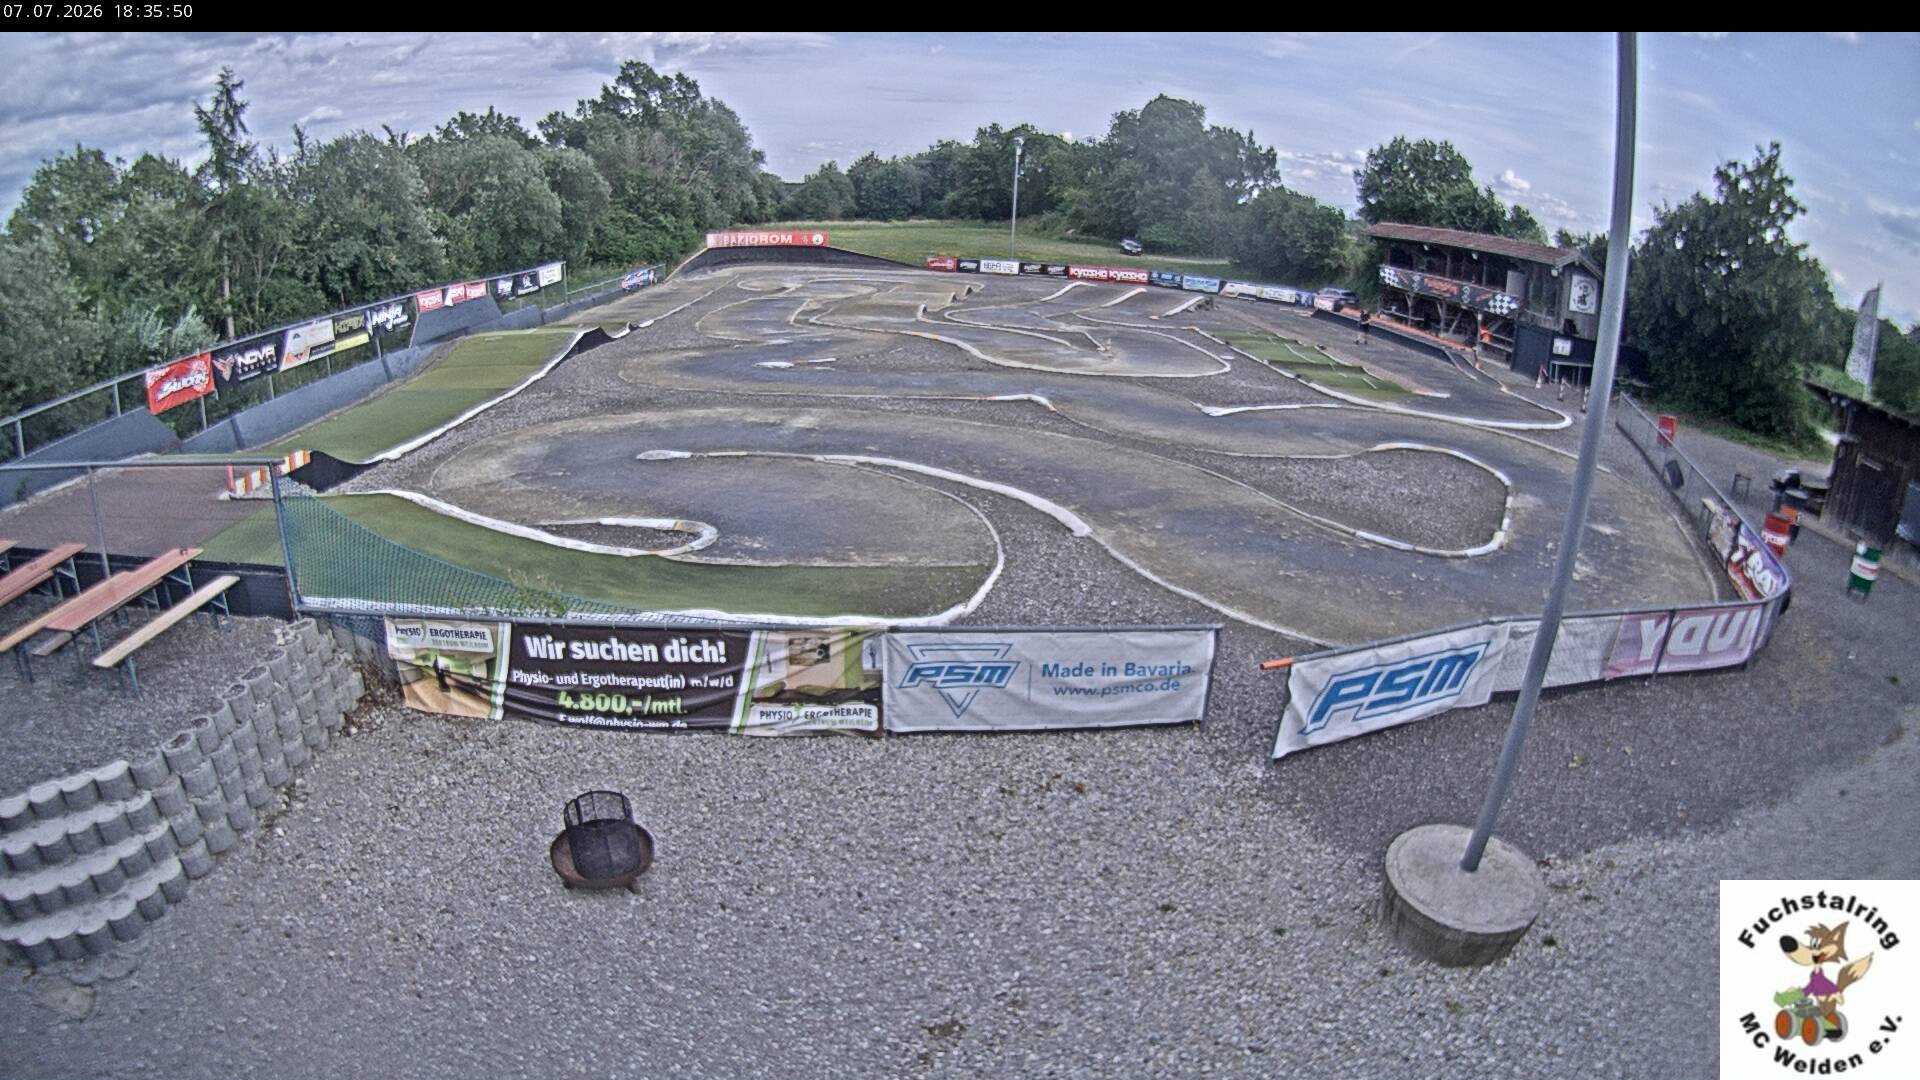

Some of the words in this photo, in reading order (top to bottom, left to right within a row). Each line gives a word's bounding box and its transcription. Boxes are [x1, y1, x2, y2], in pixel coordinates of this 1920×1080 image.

[395, 625, 421, 637] PHYSIO
[429, 627, 488, 641] ERGOTHERAPIE
[524, 635, 566, 660] Wir
[571, 637, 659, 663] suchen
[663, 638, 727, 664] dich!
[906, 661, 1018, 686] PSM
[1041, 663, 1095, 678] Made
[1101, 662, 1116, 677] in
[1124, 661, 1193, 677] Bavaria
[512, 670, 554, 687] Physio-
[556, 673, 579, 685] und
[581, 674, 686, 690] Ergotherapeut(in)
[690, 677, 734, 688] m/w/d
[1053, 678, 1181, 698] www.psmco.de
[1308, 649, 1482, 724] PSM
[760, 710, 793, 721] PHYSIO
